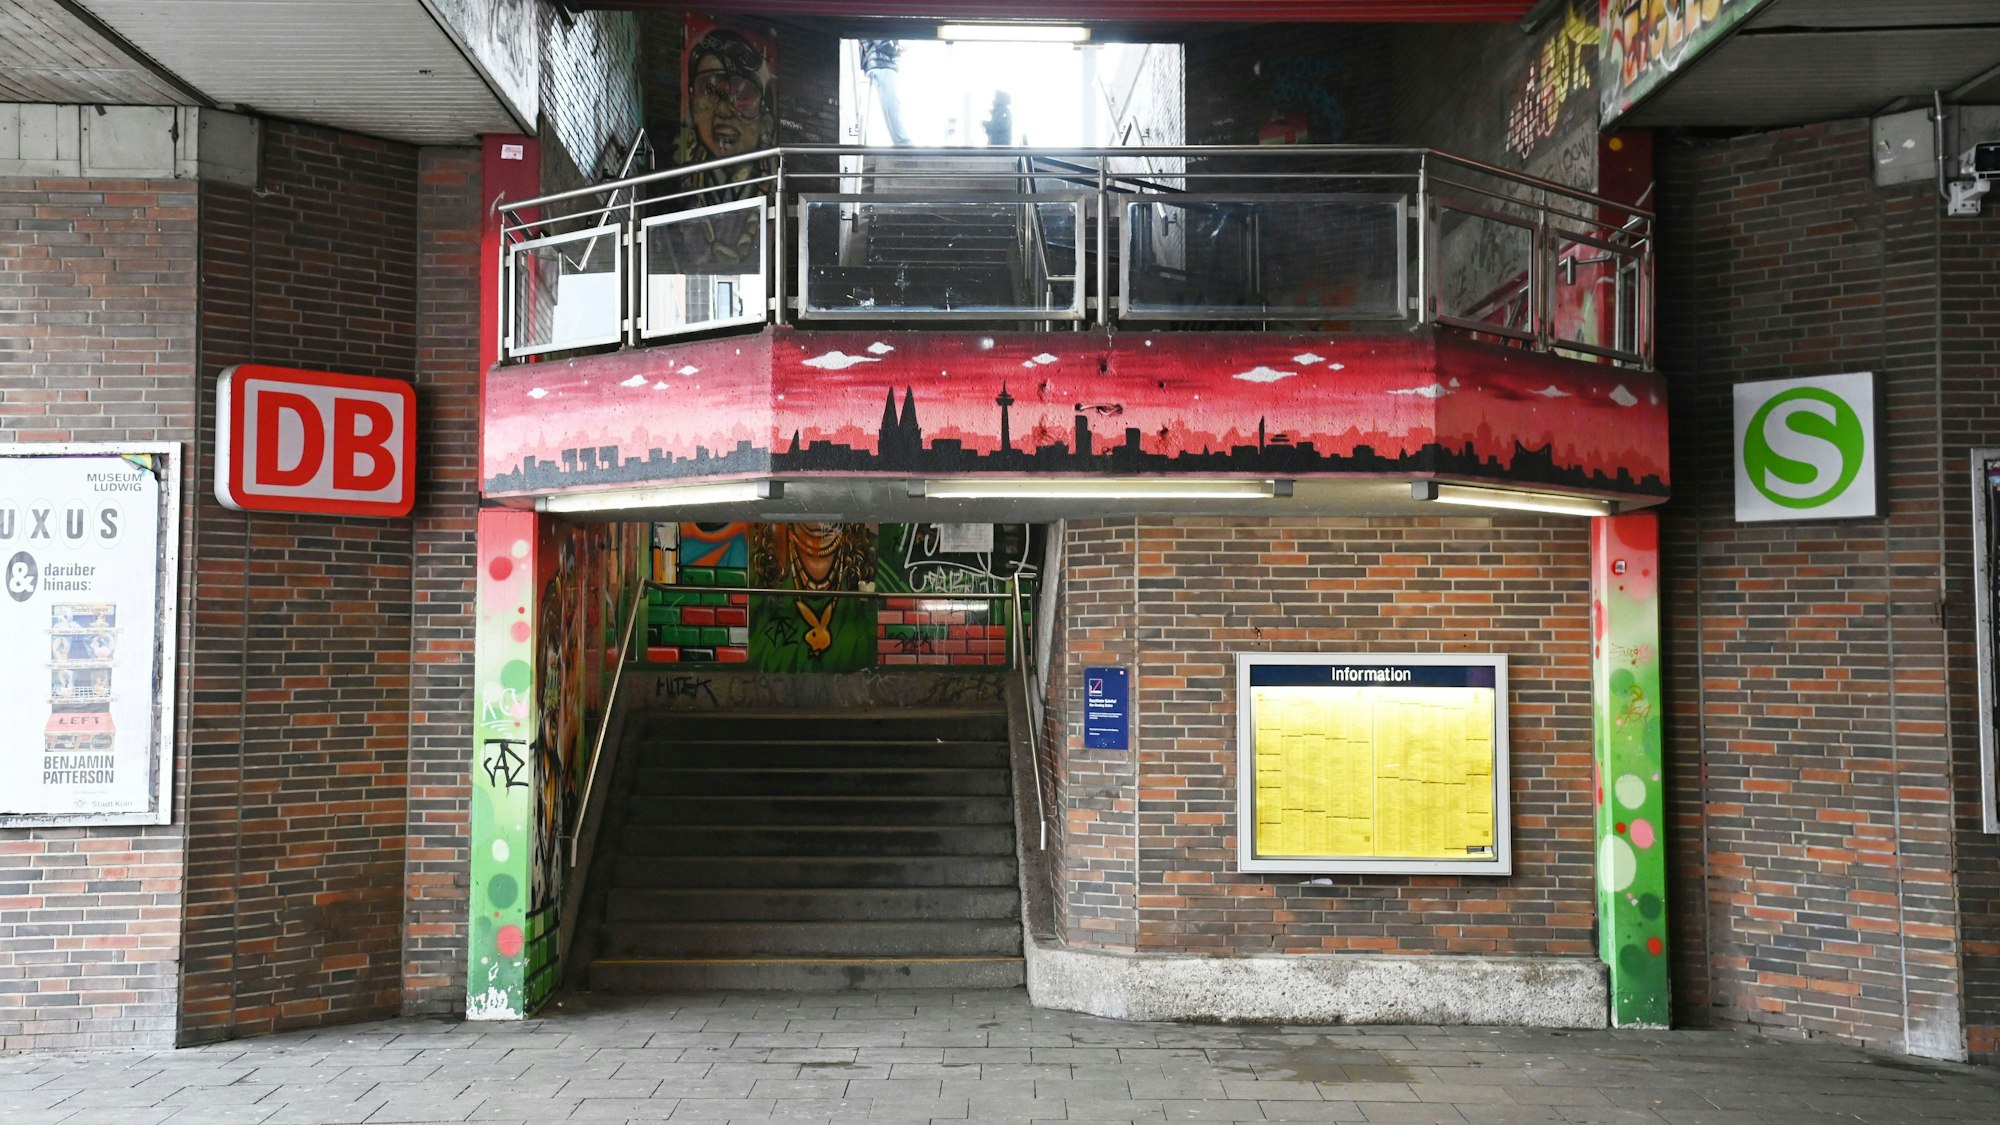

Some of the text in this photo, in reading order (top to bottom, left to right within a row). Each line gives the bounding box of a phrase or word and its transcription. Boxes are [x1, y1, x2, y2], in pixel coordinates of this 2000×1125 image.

[256, 390, 396, 492] DB
[1763, 398, 1844, 499] S
[86, 473, 142, 482] MUSEUM
[94, 483, 142, 492] LUDWIG
[44, 562, 96, 577] darüber
[9, 562, 34, 593] &
[43, 577, 92, 591] hinaus:
[1331, 667, 1411, 681] Information
[59, 717, 100, 725] LEFT
[44, 755, 115, 769] BENJAMIN
[43, 770, 114, 784] PATTERSON
[92, 799, 133, 808] Stadt Köln
